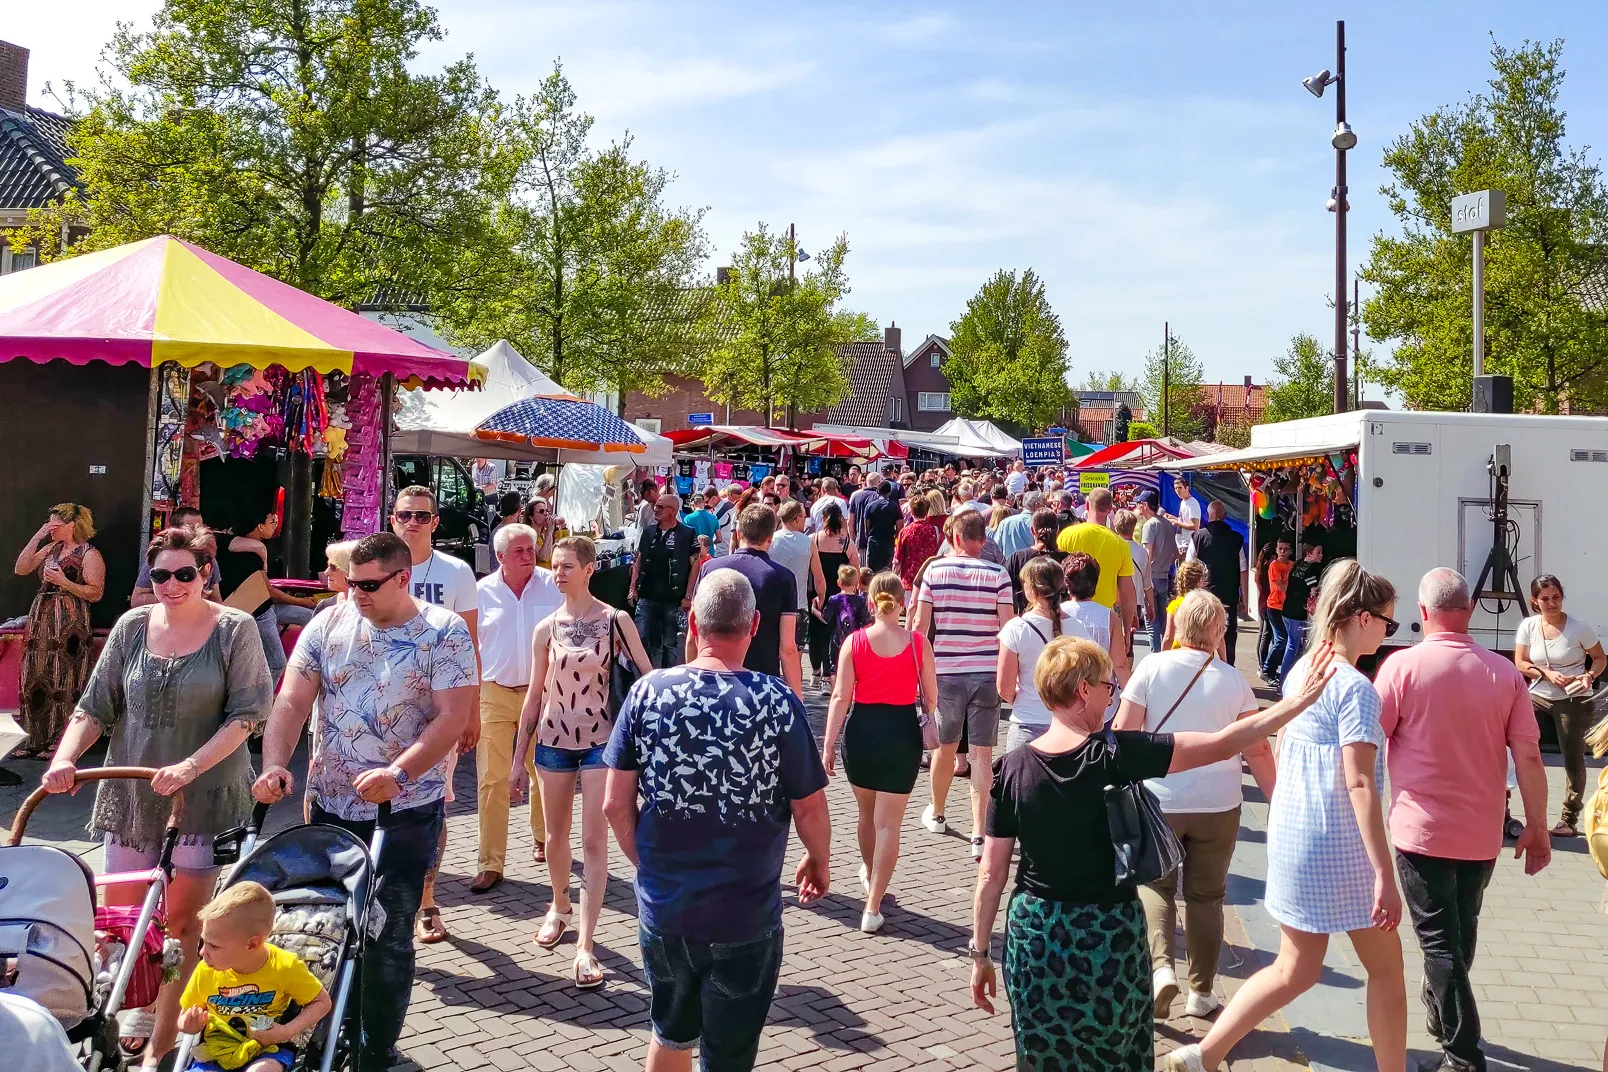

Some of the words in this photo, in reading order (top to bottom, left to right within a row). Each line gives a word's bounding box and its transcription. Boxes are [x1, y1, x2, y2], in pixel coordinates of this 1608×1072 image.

[1024, 442, 1062, 450] VIETNAMESE
[1025, 450, 1061, 459] LOEMPIA'S
[410, 582, 444, 605] FIE
[207, 990, 276, 1007] RACING
